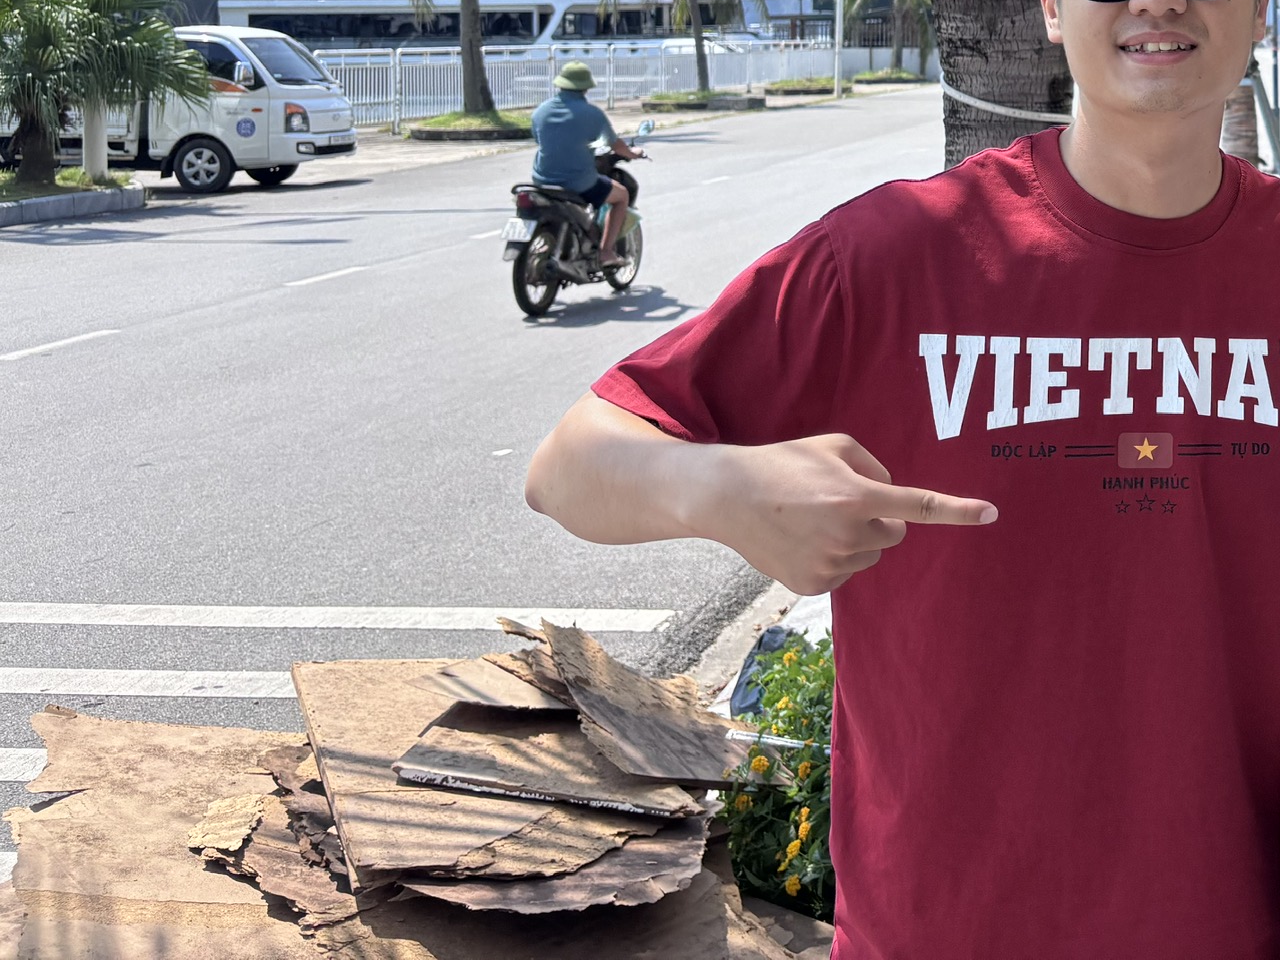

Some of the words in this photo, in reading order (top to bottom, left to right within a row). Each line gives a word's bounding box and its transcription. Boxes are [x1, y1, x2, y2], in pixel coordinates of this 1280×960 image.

[1029, 441, 1057, 461] LẬP
[1231, 442, 1248, 459] TỰ
[1251, 442, 1271, 455] DO
[1150, 473, 1190, 490] PHÚC
